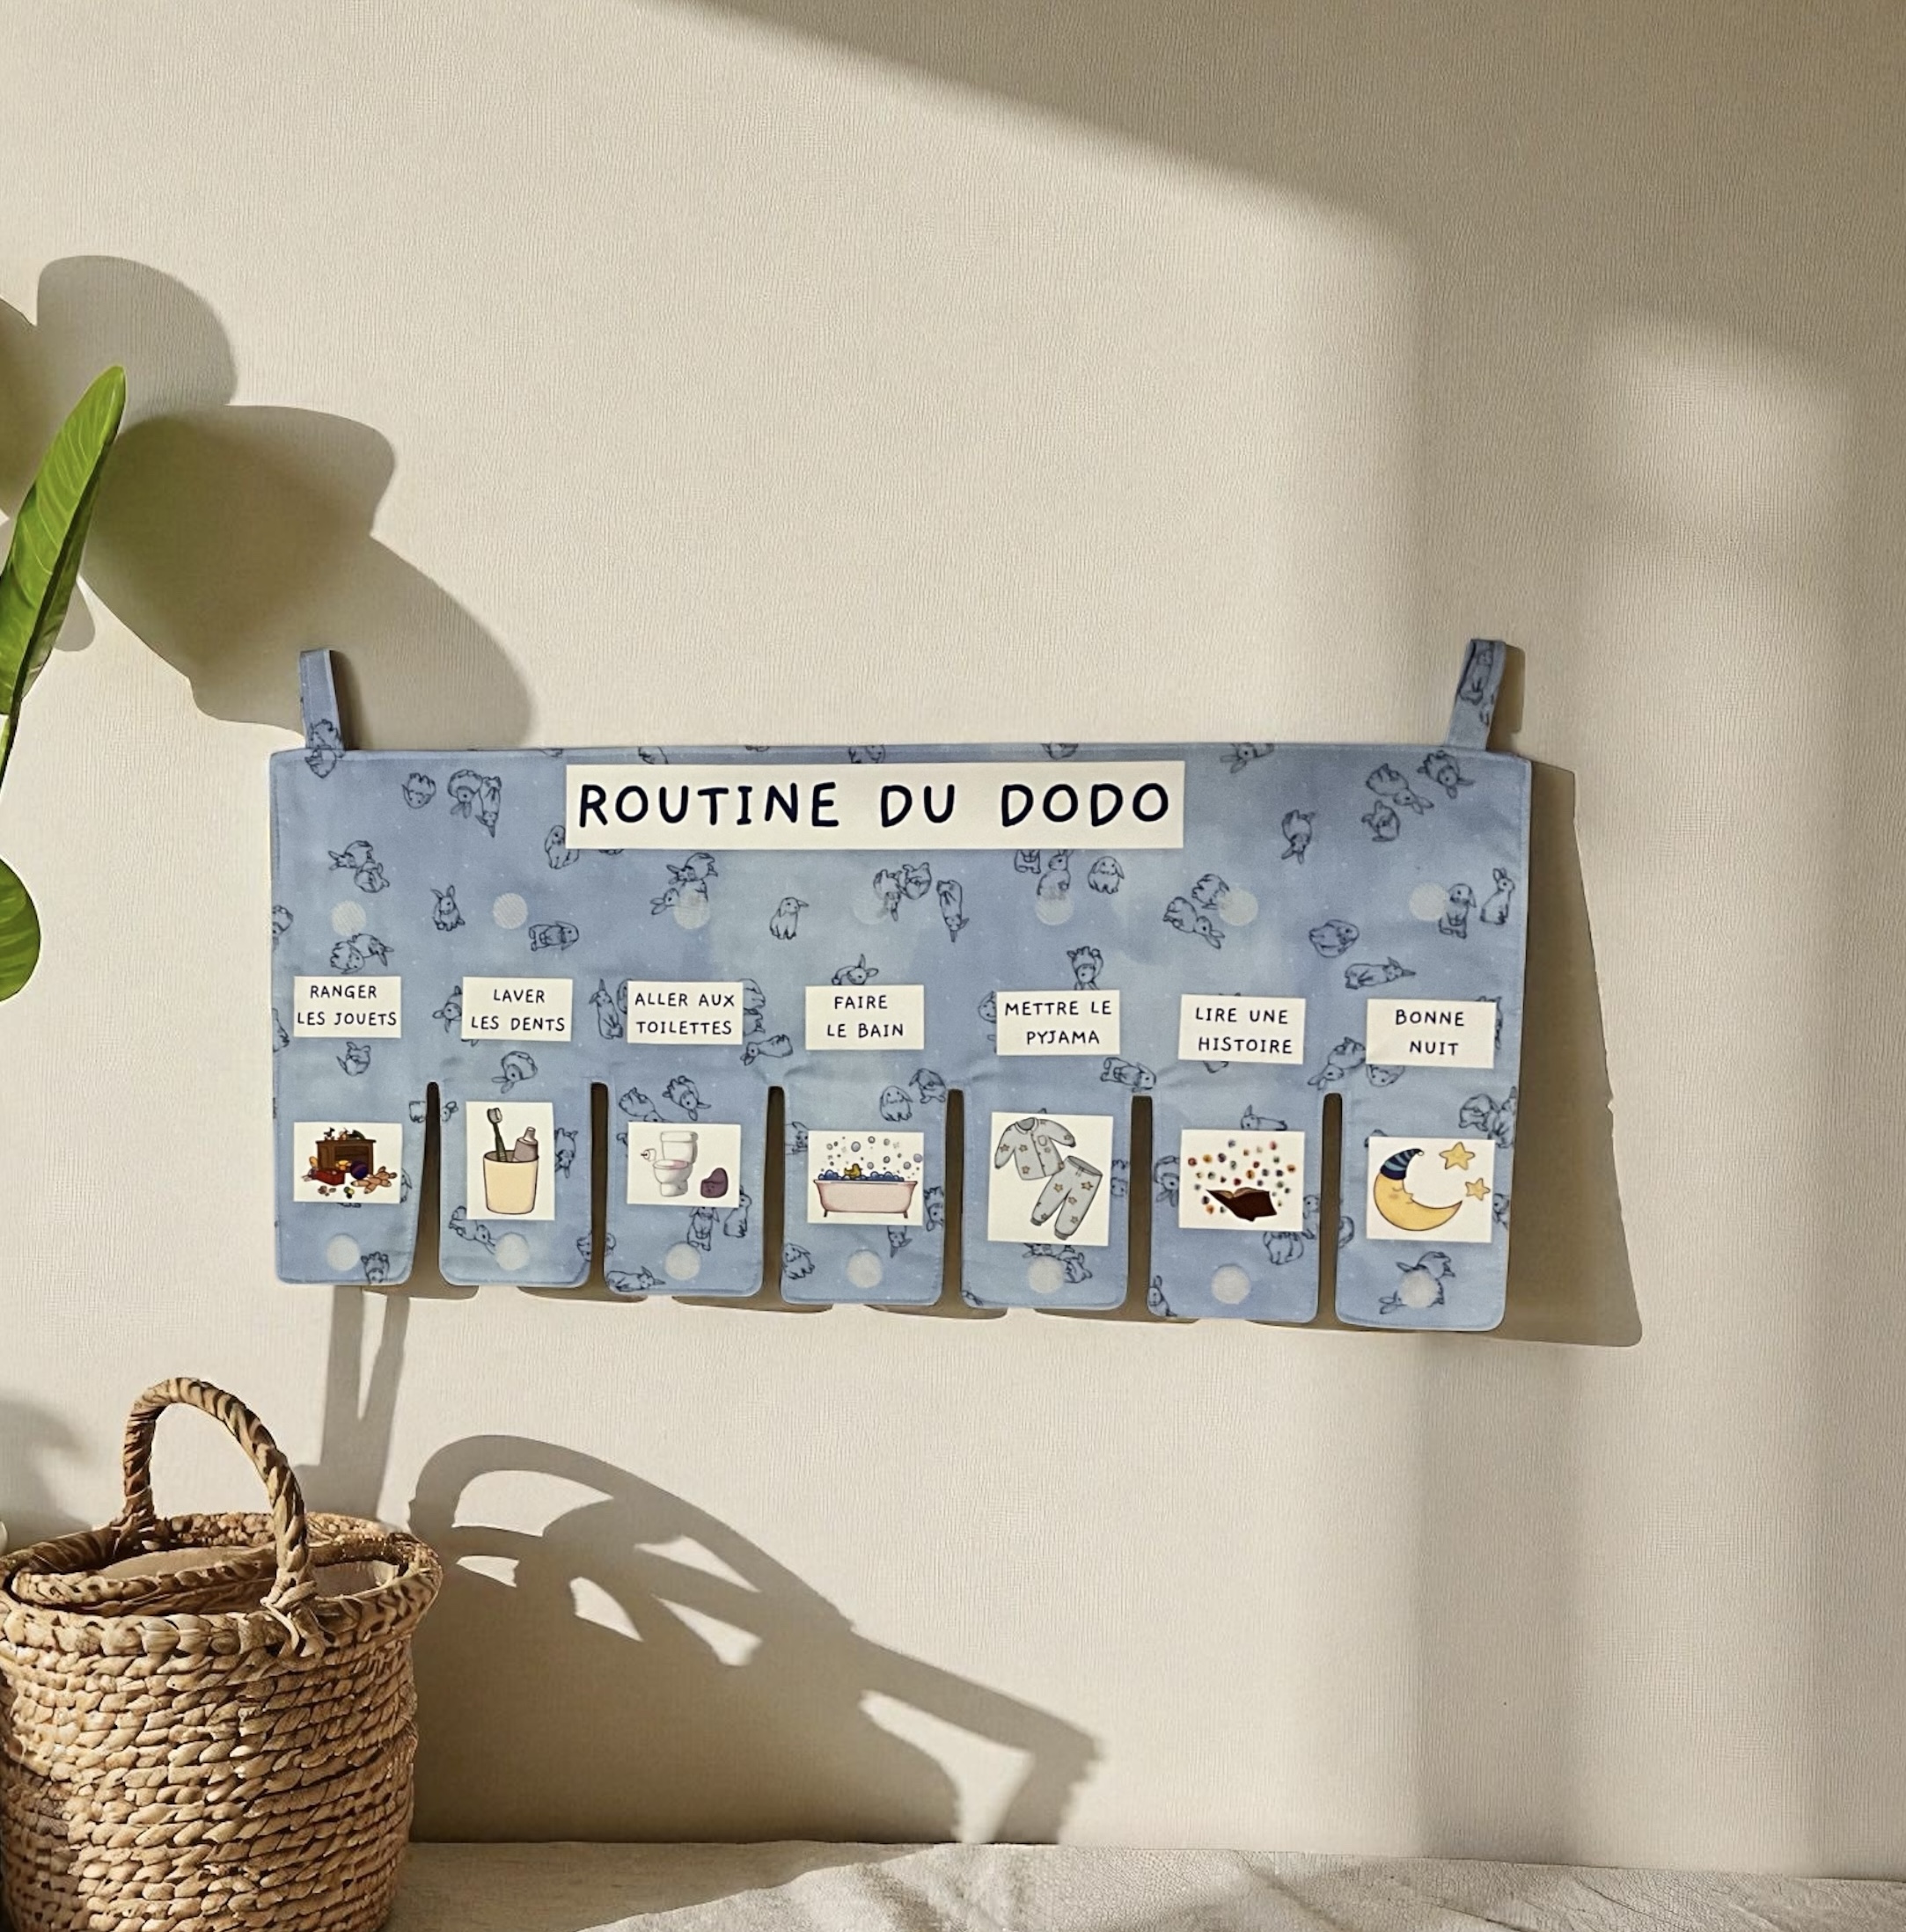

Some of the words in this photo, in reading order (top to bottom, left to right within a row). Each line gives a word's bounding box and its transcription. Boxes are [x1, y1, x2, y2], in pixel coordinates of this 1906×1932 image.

[579, 781, 839, 828] ROUTINE
[880, 783, 956, 829] DU
[1001, 782, 1169, 828] DODO
[310, 984, 377, 999] RANGER
[493, 988, 545, 1004] LAVER
[634, 992, 688, 1007] ALLER
[698, 993, 735, 1007] AUX
[834, 994, 888, 1010] FAIRE
[1004, 1000, 1079, 1016] METTRE
[1090, 999, 1112, 1015] LE
[297, 1011, 326, 1026] LES
[334, 1011, 397, 1027] JOUETS
[471, 1015, 500, 1030] LES
[510, 1016, 565, 1032] DENTS
[1195, 1006, 1237, 1023] LIRE
[1250, 1009, 1288, 1025] UNE
[1395, 1008, 1465, 1027] BONNE
[635, 1020, 732, 1036] TOILETTES
[826, 1023, 847, 1038] LE
[858, 1022, 904, 1039] BAIN
[1026, 1029, 1100, 1045] PYJAMA
[1198, 1036, 1293, 1055] HISTOIRE
[1409, 1040, 1459, 1056] NUIT
